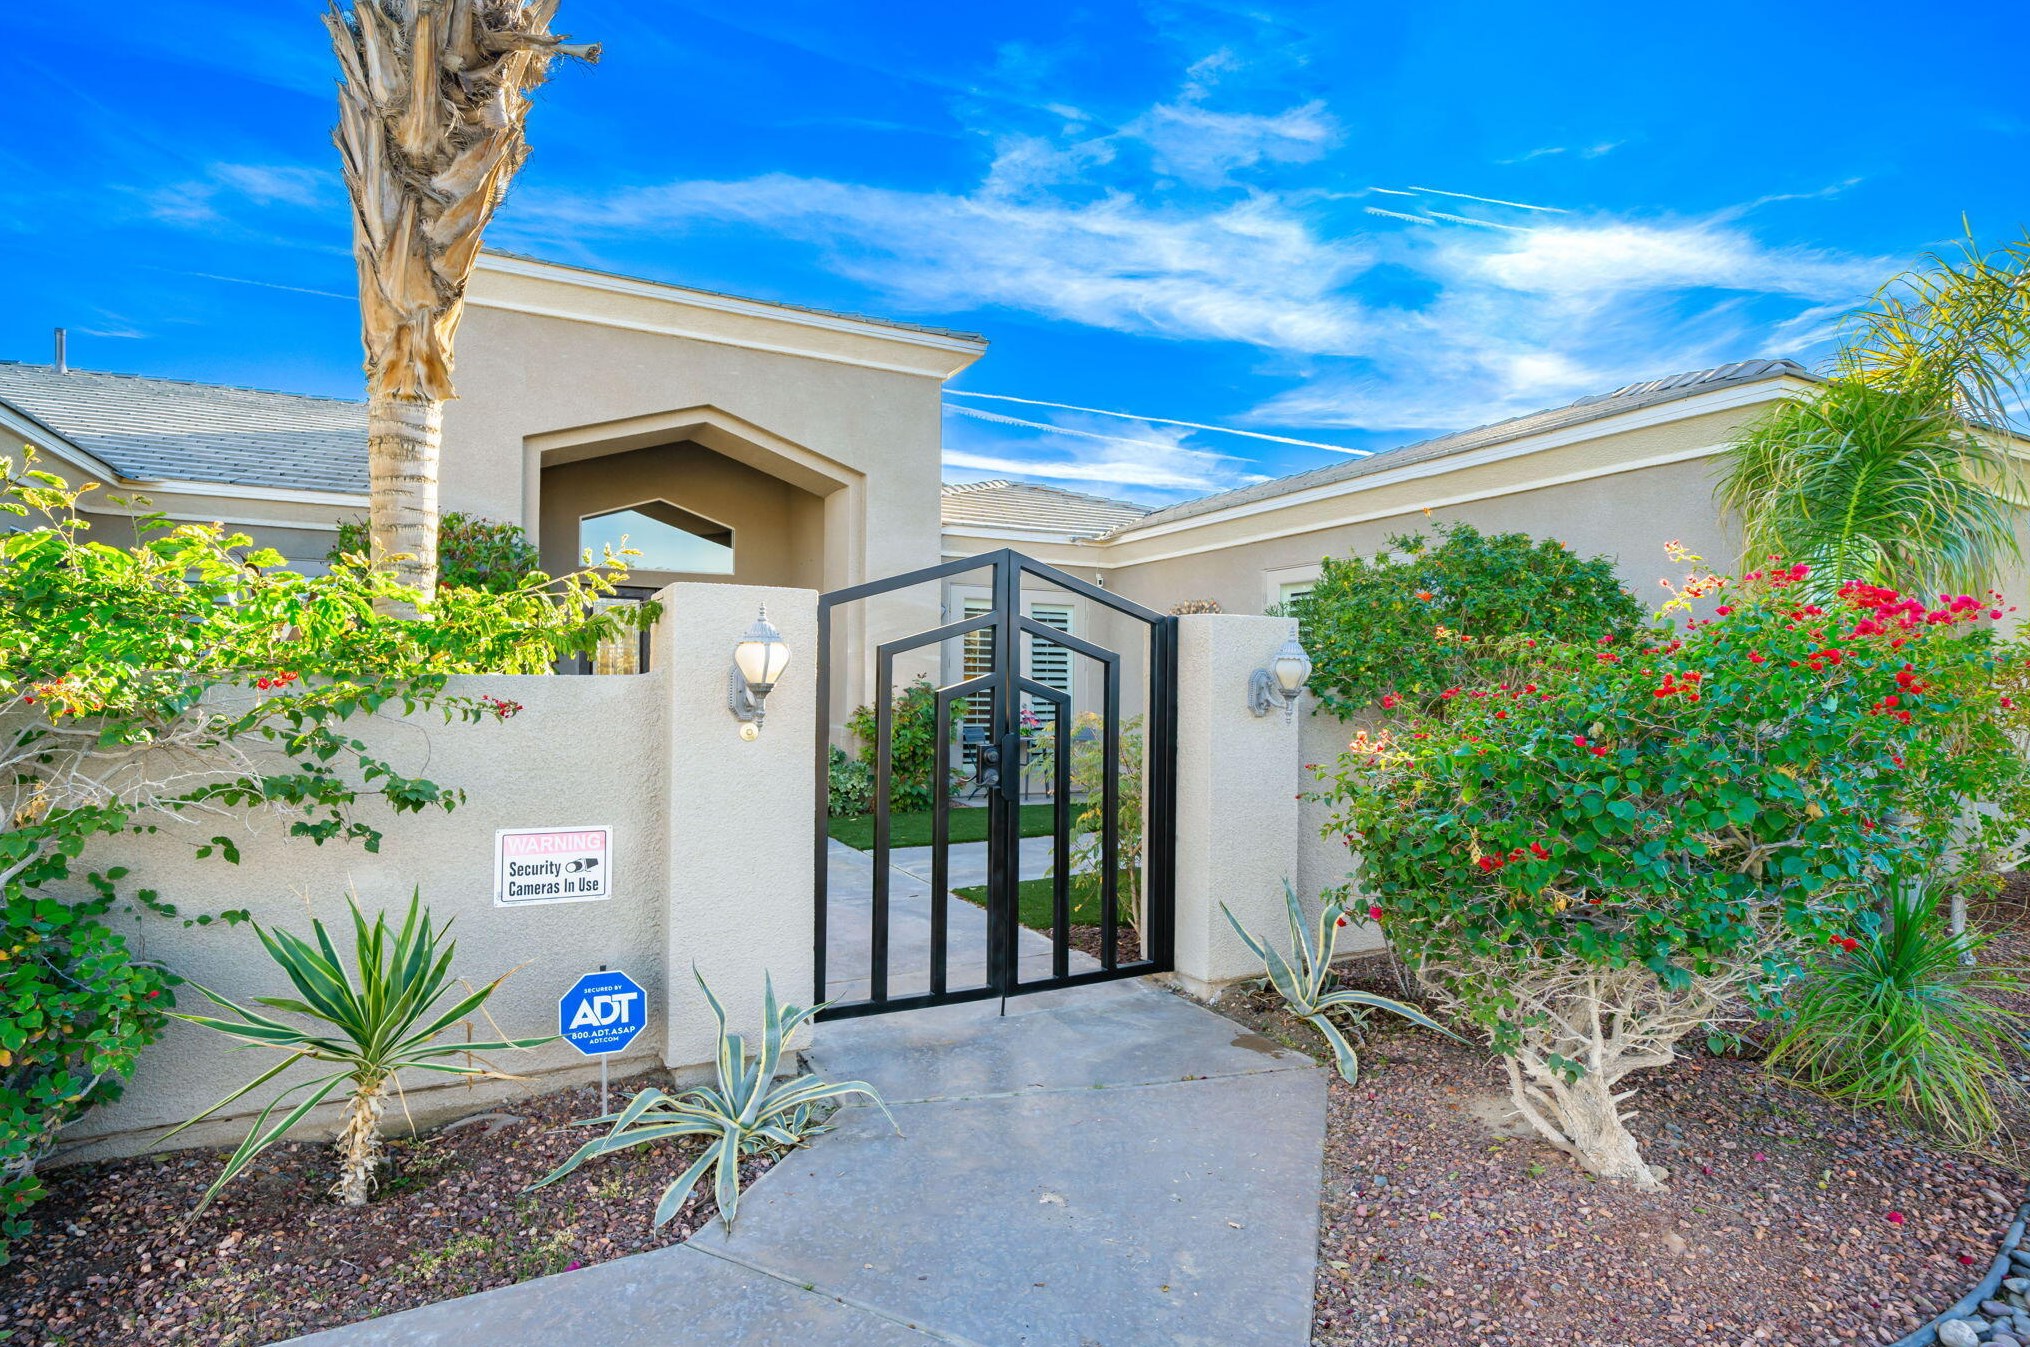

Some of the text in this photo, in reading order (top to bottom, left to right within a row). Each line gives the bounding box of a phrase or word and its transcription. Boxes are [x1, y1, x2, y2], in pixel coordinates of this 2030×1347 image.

[508, 833, 601, 852] WARNING
[509, 860, 561, 877] Security
[509, 877, 599, 896] Cameras In Use
[584, 985, 613, 994] SECURED
[569, 992, 638, 1029] ADT
[571, 1025, 636, 1040] 800.ADT.ASAP
[589, 1036, 619, 1044] ADT.COM
